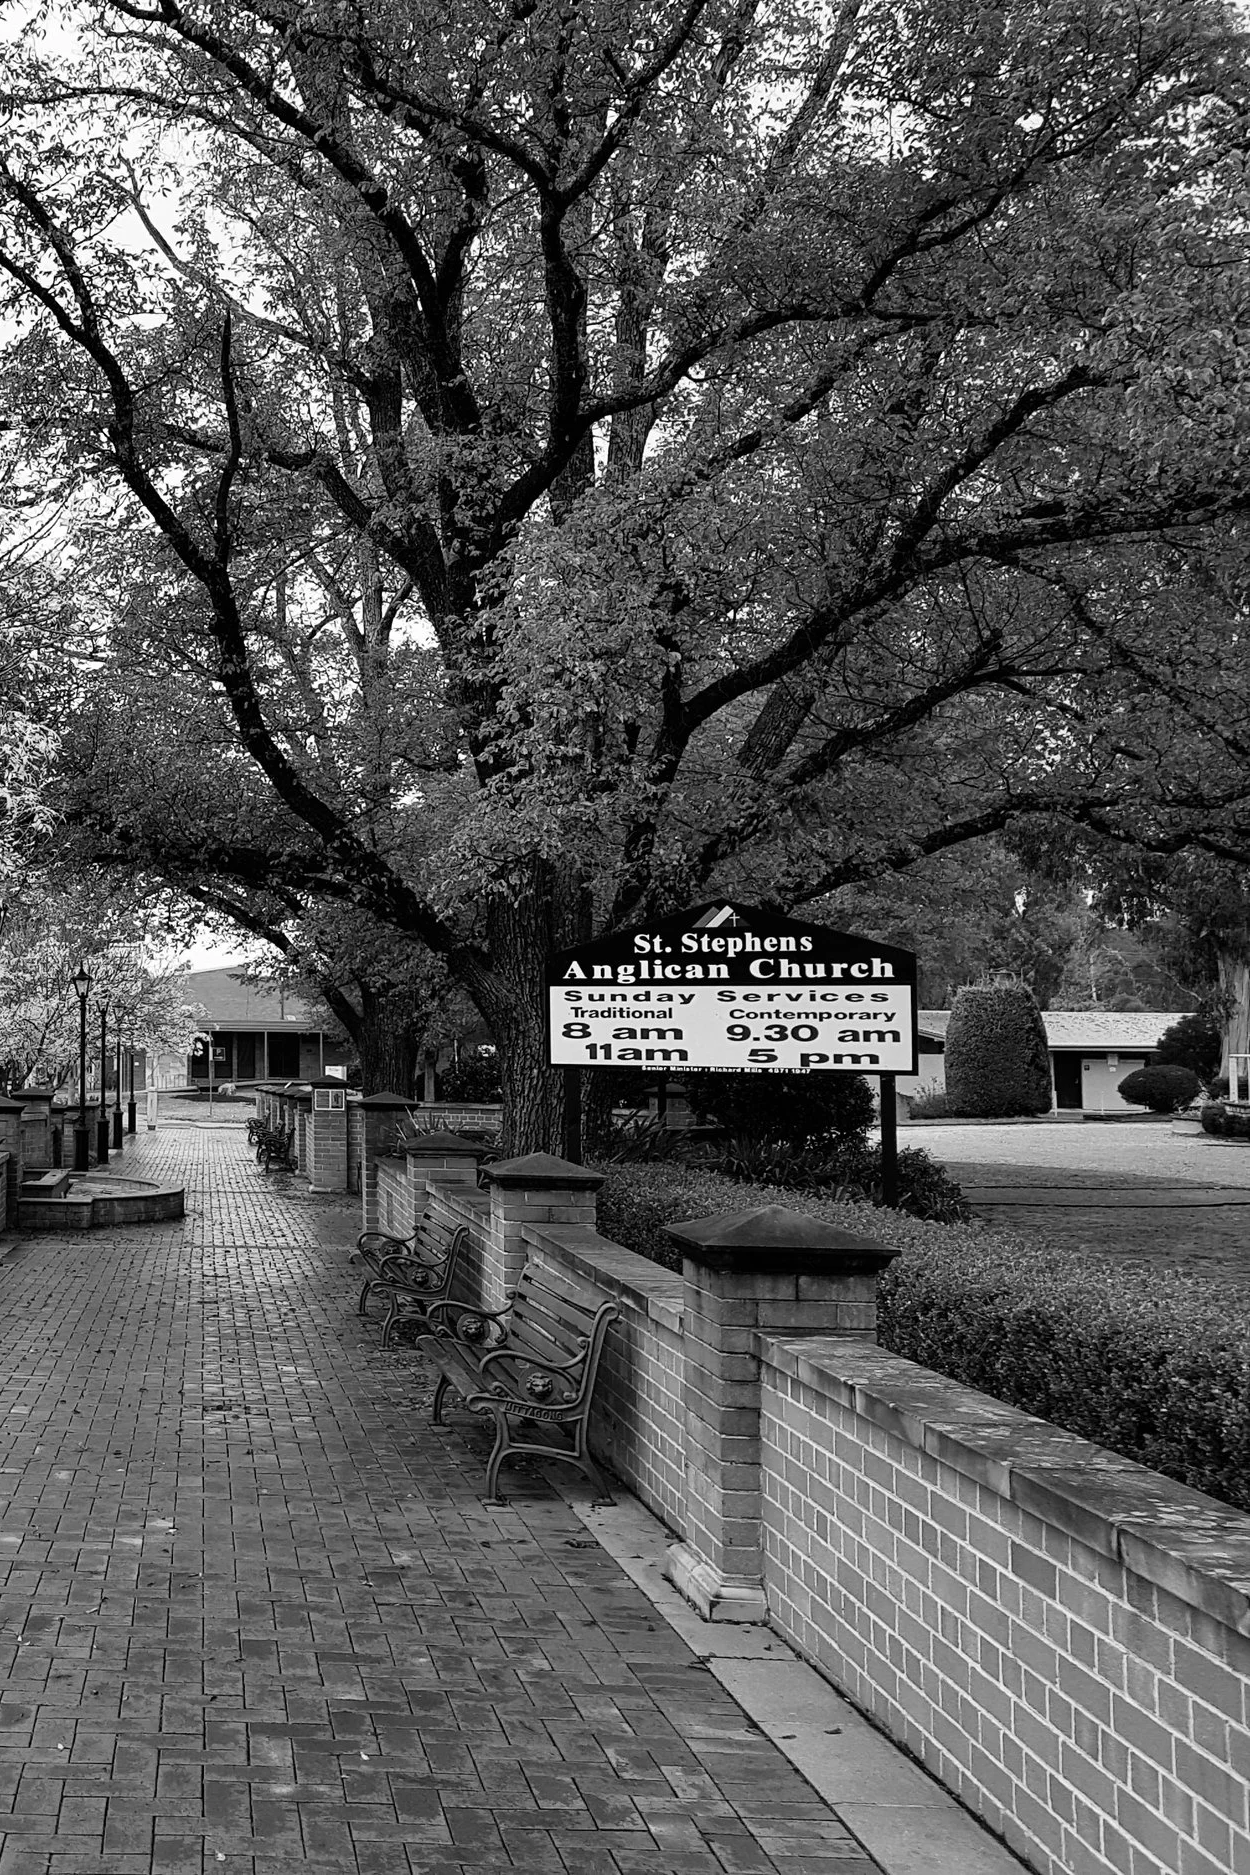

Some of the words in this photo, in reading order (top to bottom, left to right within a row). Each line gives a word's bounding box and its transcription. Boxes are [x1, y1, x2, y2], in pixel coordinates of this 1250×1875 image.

[634, 933, 672, 954] St.
[681, 932, 813, 958] Stephens
[562, 959, 731, 984] Anglican
[749, 957, 895, 979] Church
[564, 990, 696, 1005] Sunday
[716, 989, 889, 1003] Services
[570, 1007, 673, 1019] Traditional
[729, 1009, 897, 1022] Contemporary
[562, 1022, 592, 1039] 8
[612, 1027, 684, 1040] am
[726, 1024, 819, 1042] 9.30
[837, 1029, 901, 1043] am
[585, 1043, 689, 1061] 11am
[747, 1049, 779, 1064] 5
[800, 1052, 880, 1068] pm
